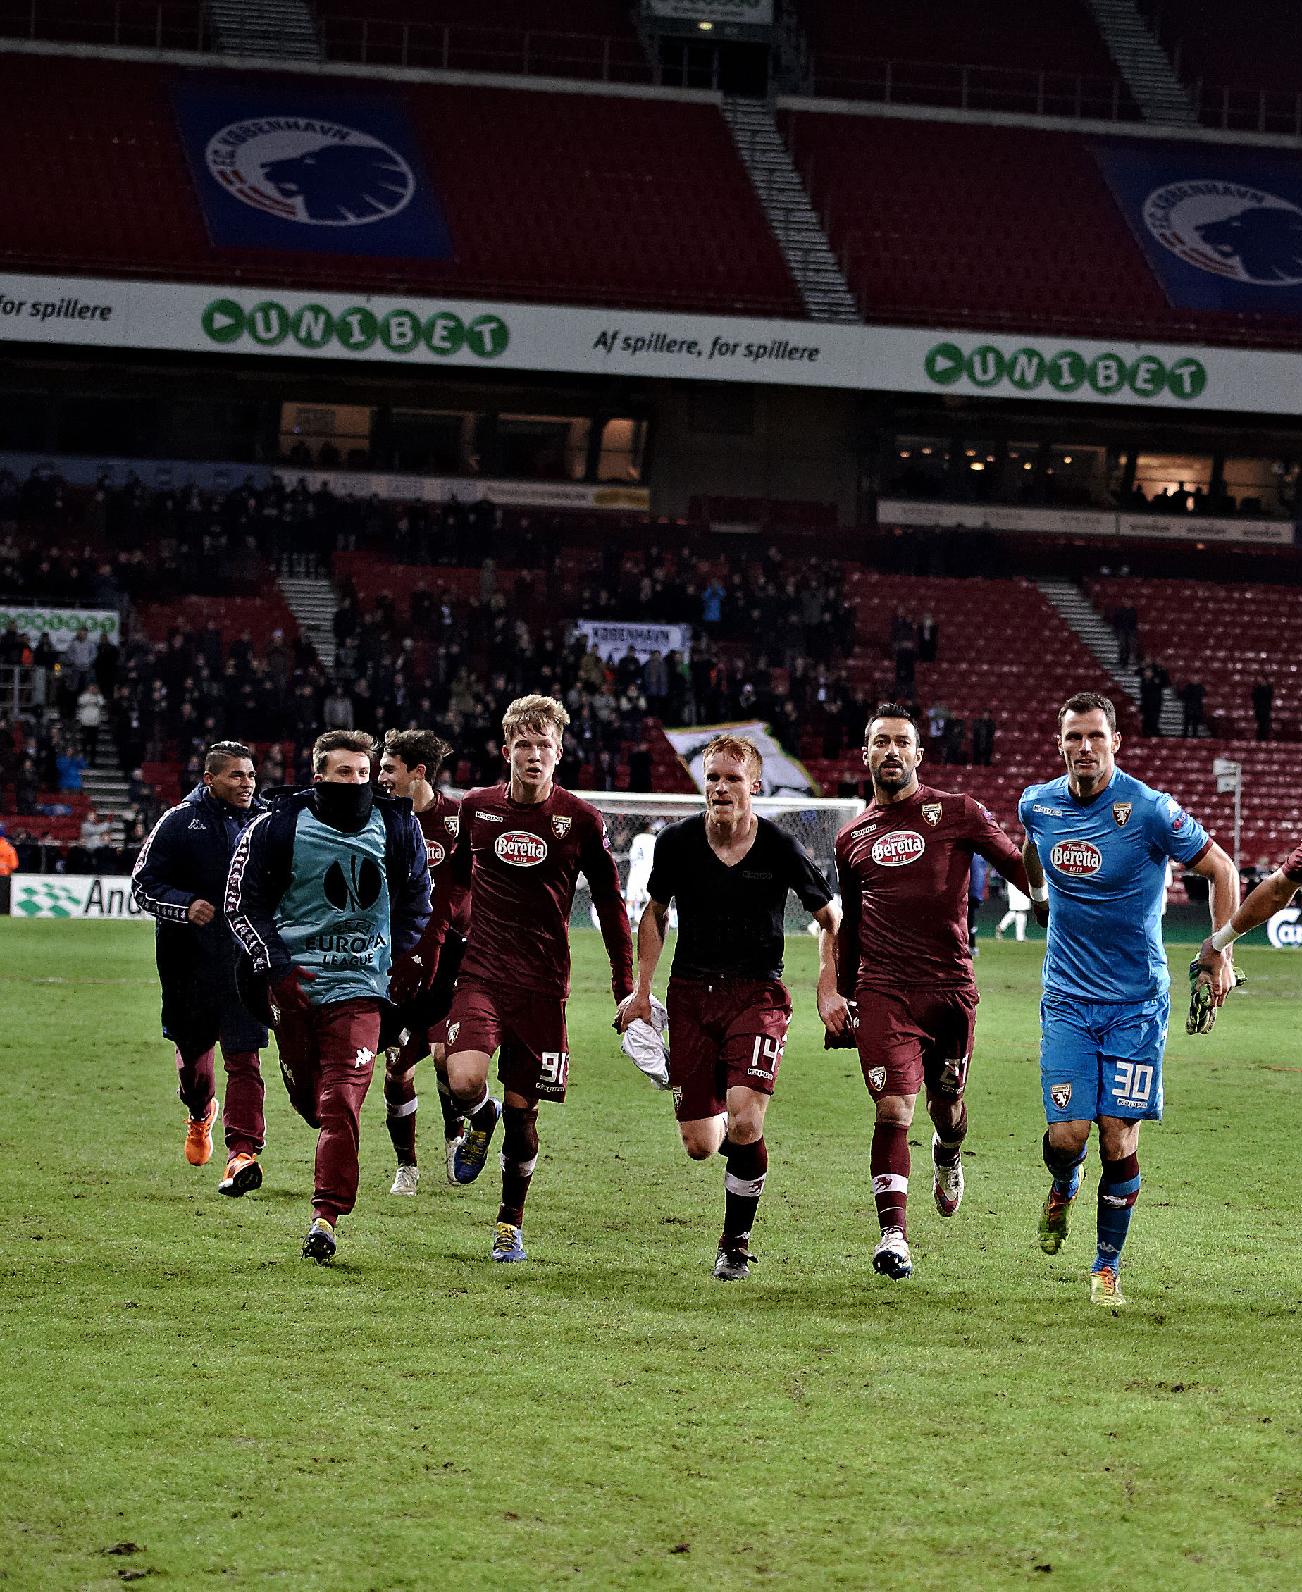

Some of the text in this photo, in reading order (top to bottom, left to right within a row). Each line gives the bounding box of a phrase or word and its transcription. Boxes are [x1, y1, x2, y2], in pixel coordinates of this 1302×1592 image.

[30, 298, 112, 321] spillere
[248, 301, 508, 358] UNIBET
[593, 330, 820, 362] Af spillere, for spillere
[966, 346, 1206, 399] UNIBET
[498, 837, 544, 858] Beretta
[872, 838, 922, 860] Beretta
[1051, 846, 1099, 867] Beretta
[305, 932, 387, 954] EUROPA
[322, 953, 374, 966] LEAGUE
[1111, 1060, 1154, 1100] 30
